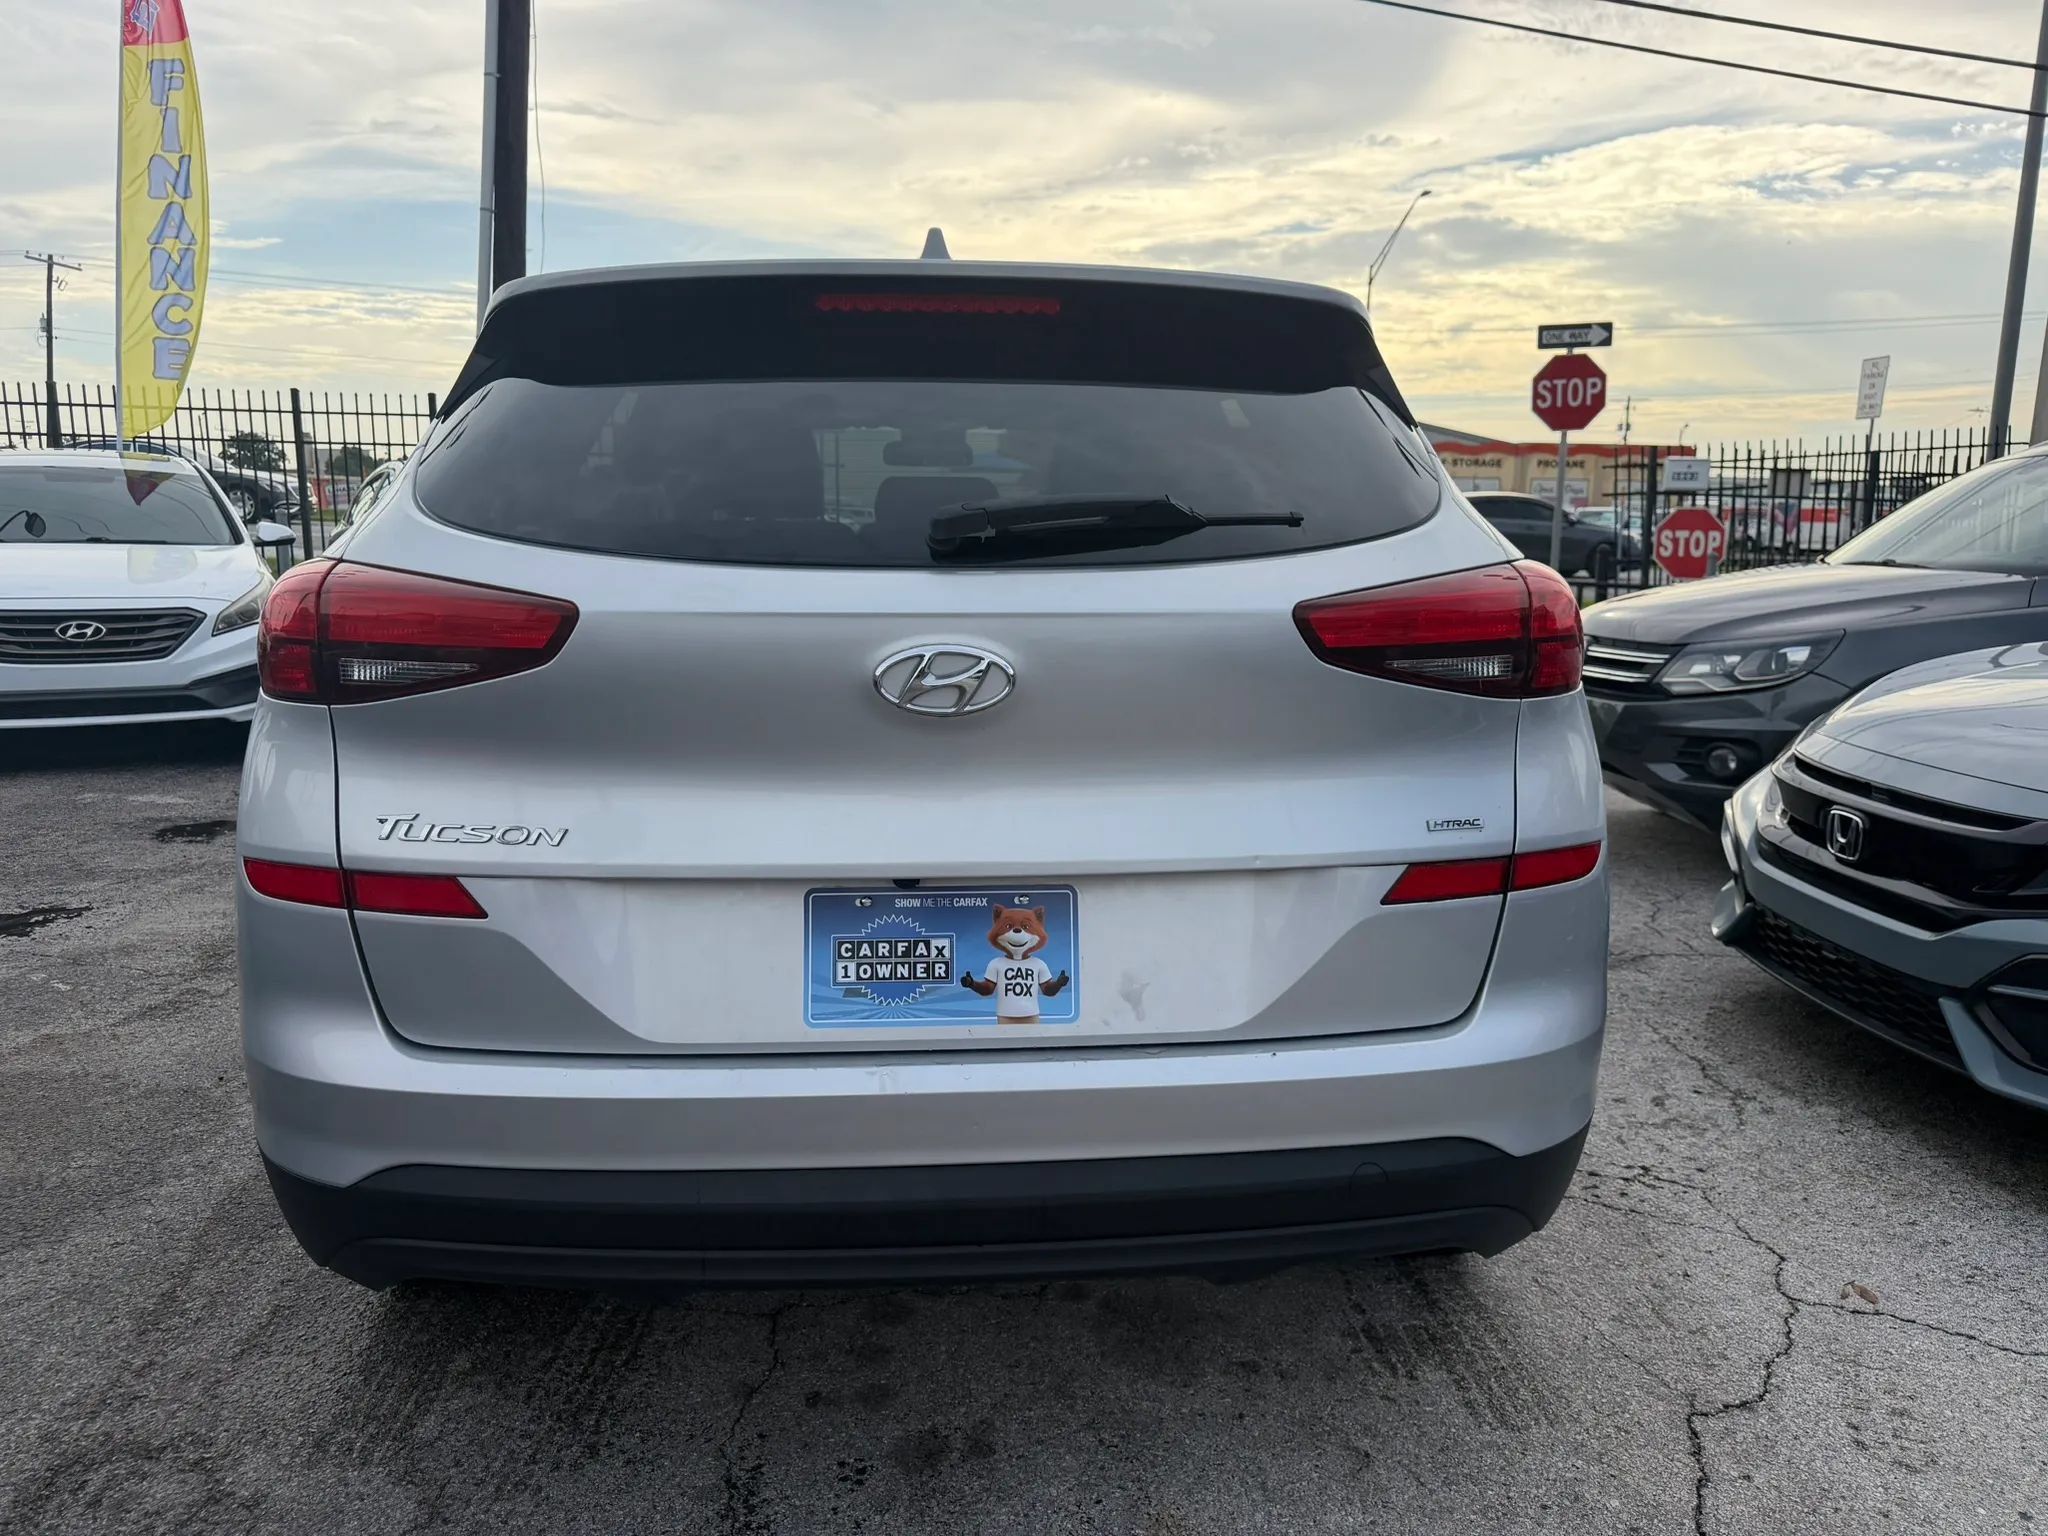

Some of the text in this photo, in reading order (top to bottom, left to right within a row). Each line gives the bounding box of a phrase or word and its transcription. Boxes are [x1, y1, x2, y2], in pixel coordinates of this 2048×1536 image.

[147, 58, 196, 381] FINANCE
[1545, 330, 1589, 342] ONE WAY
[1536, 377, 1602, 409] STOP
[1537, 459, 1585, 468] PROANE
[1659, 529, 1722, 557] STOP
[894, 897, 988, 908] SHOW ME THE CARFAX
[839, 942, 947, 959] CARFAX
[858, 963, 948, 980] OWNER
[1003, 967, 1035, 982] CAR
[1004, 982, 1033, 997] FOX
